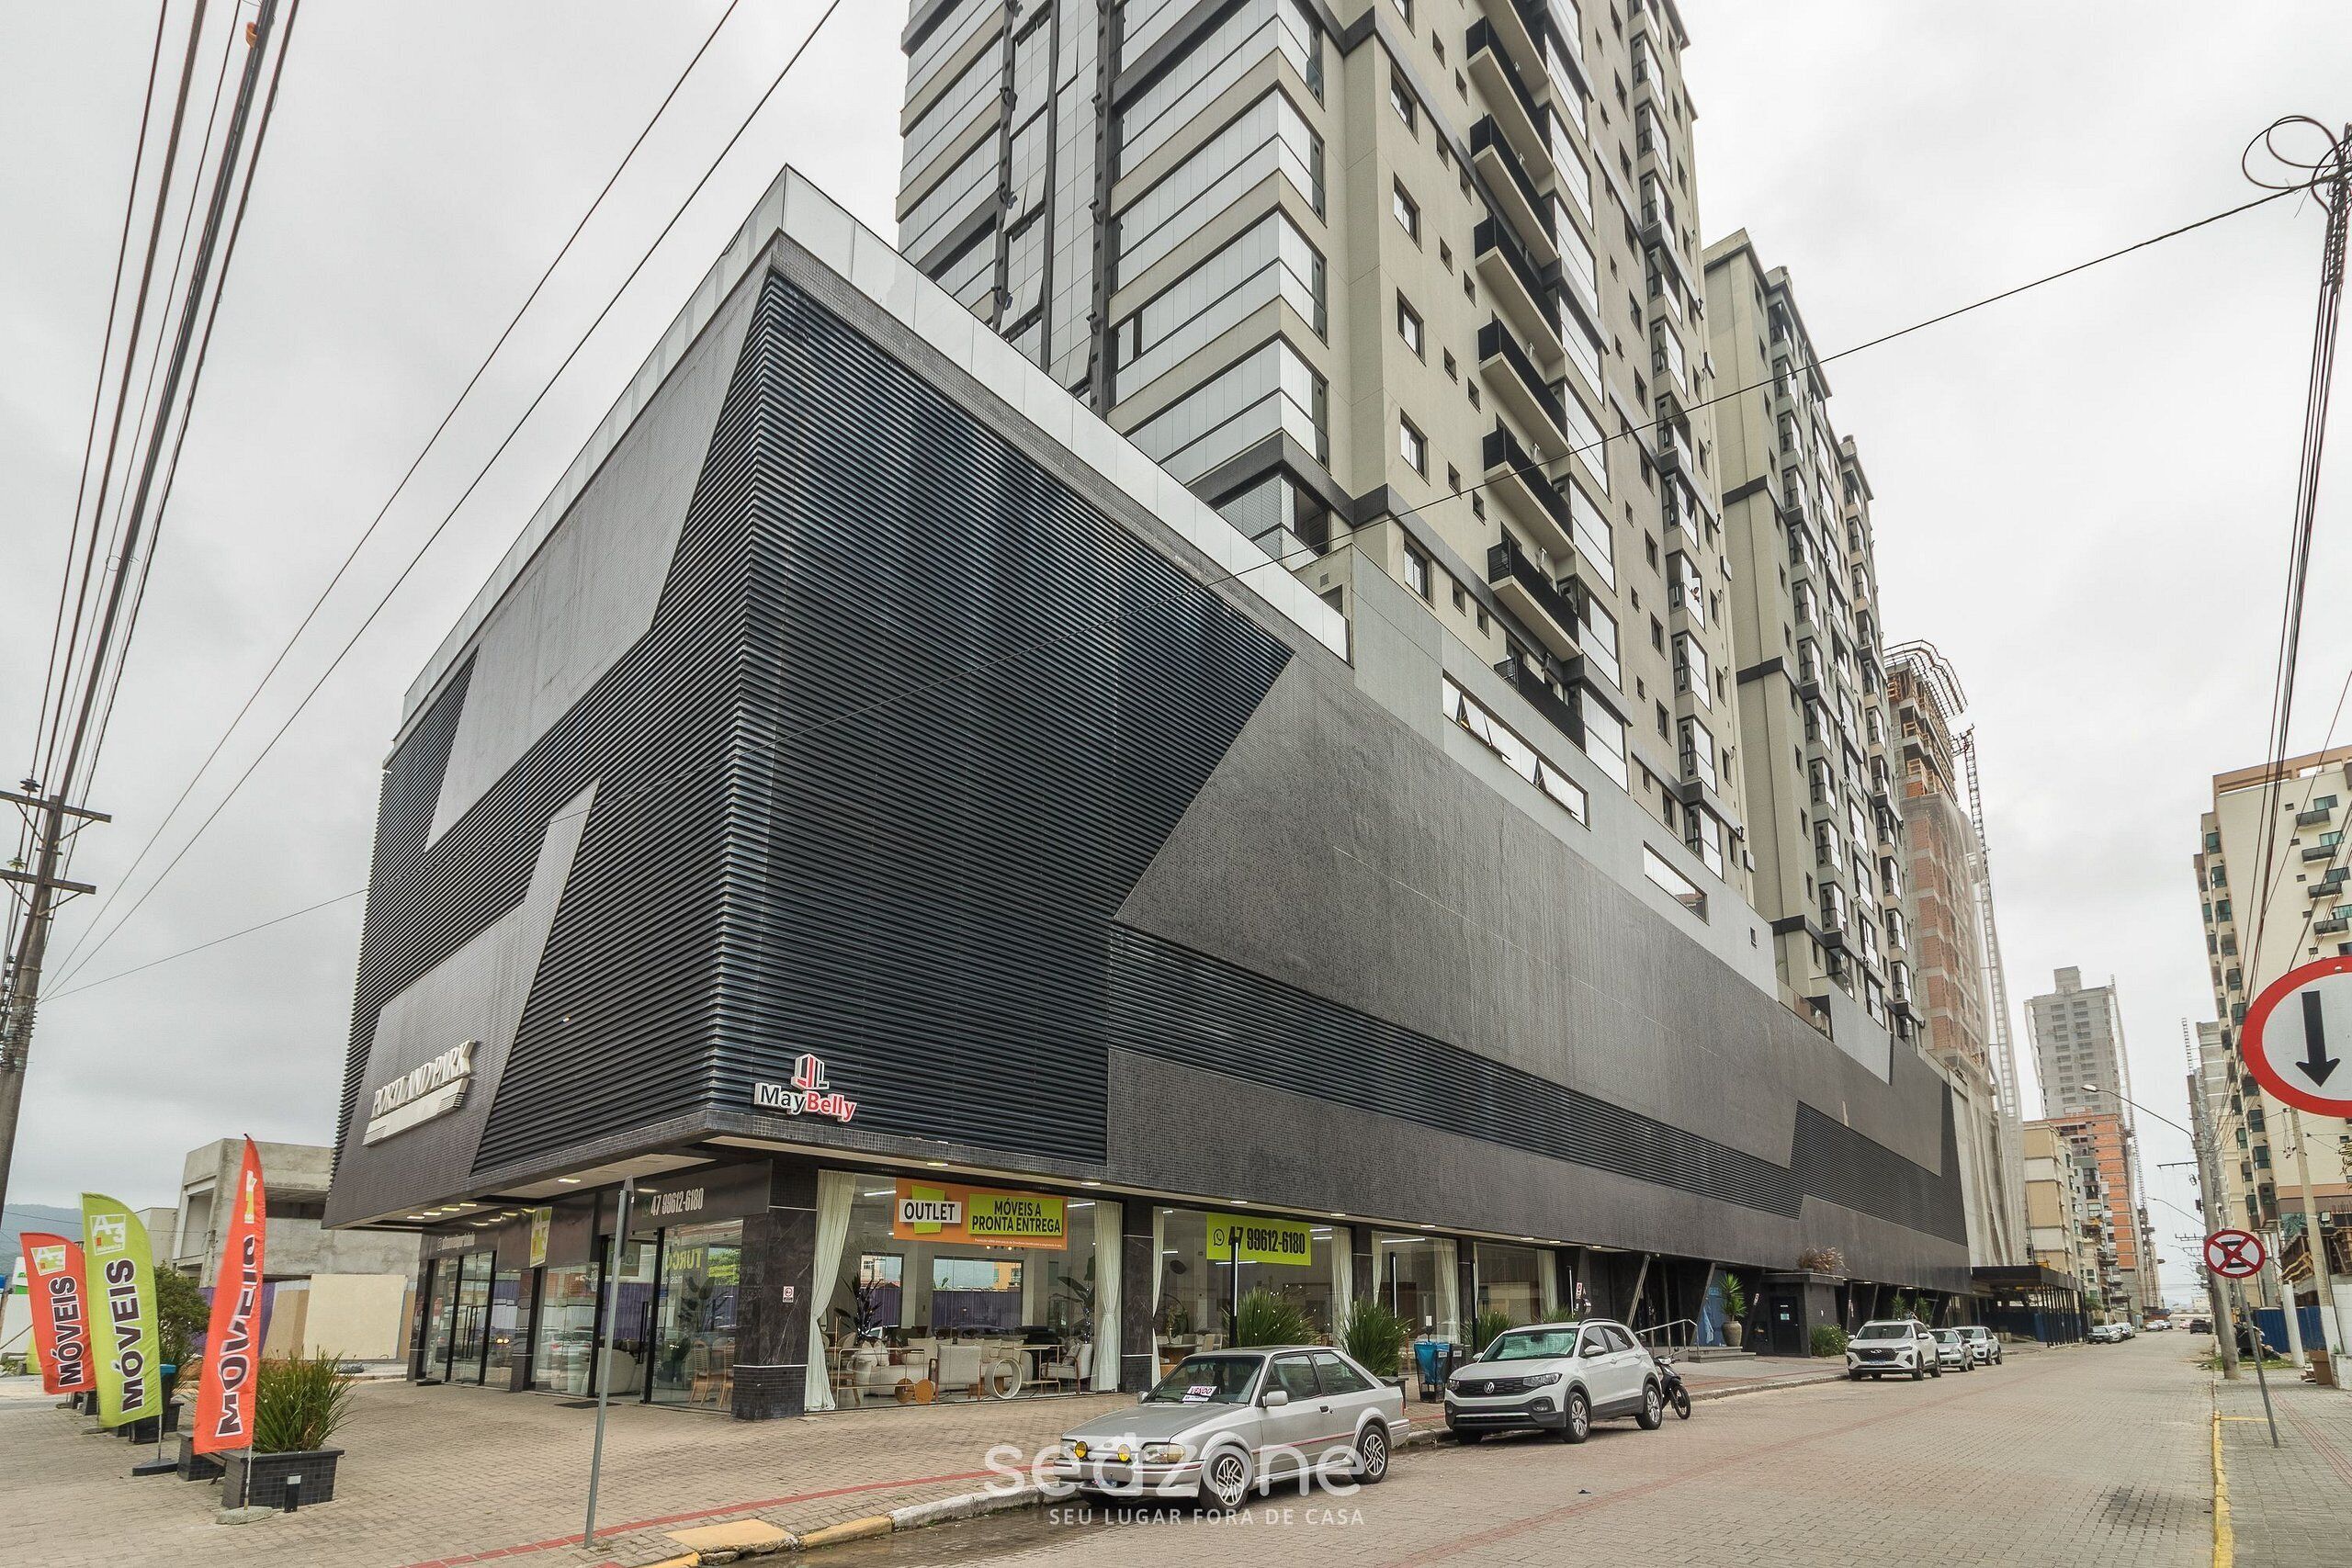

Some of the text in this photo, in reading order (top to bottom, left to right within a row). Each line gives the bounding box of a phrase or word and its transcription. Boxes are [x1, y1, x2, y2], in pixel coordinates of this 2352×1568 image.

[370, 1040, 475, 1119] PORTLAND PARK
[754, 1083, 857, 1122] MayBelly
[650, 1188, 705, 1216] 47 99612-6180
[904, 1201, 956, 1221] OUTLET
[994, 1198, 1042, 1217] MÓVEIS A
[972, 1215, 1061, 1233] PRONTA ENTREGA
[1228, 1225, 1306, 1255] 47 99612-6180
[49, 1276, 85, 1387] MÓVEIS
[105, 1258, 144, 1413] MÓVEIS
